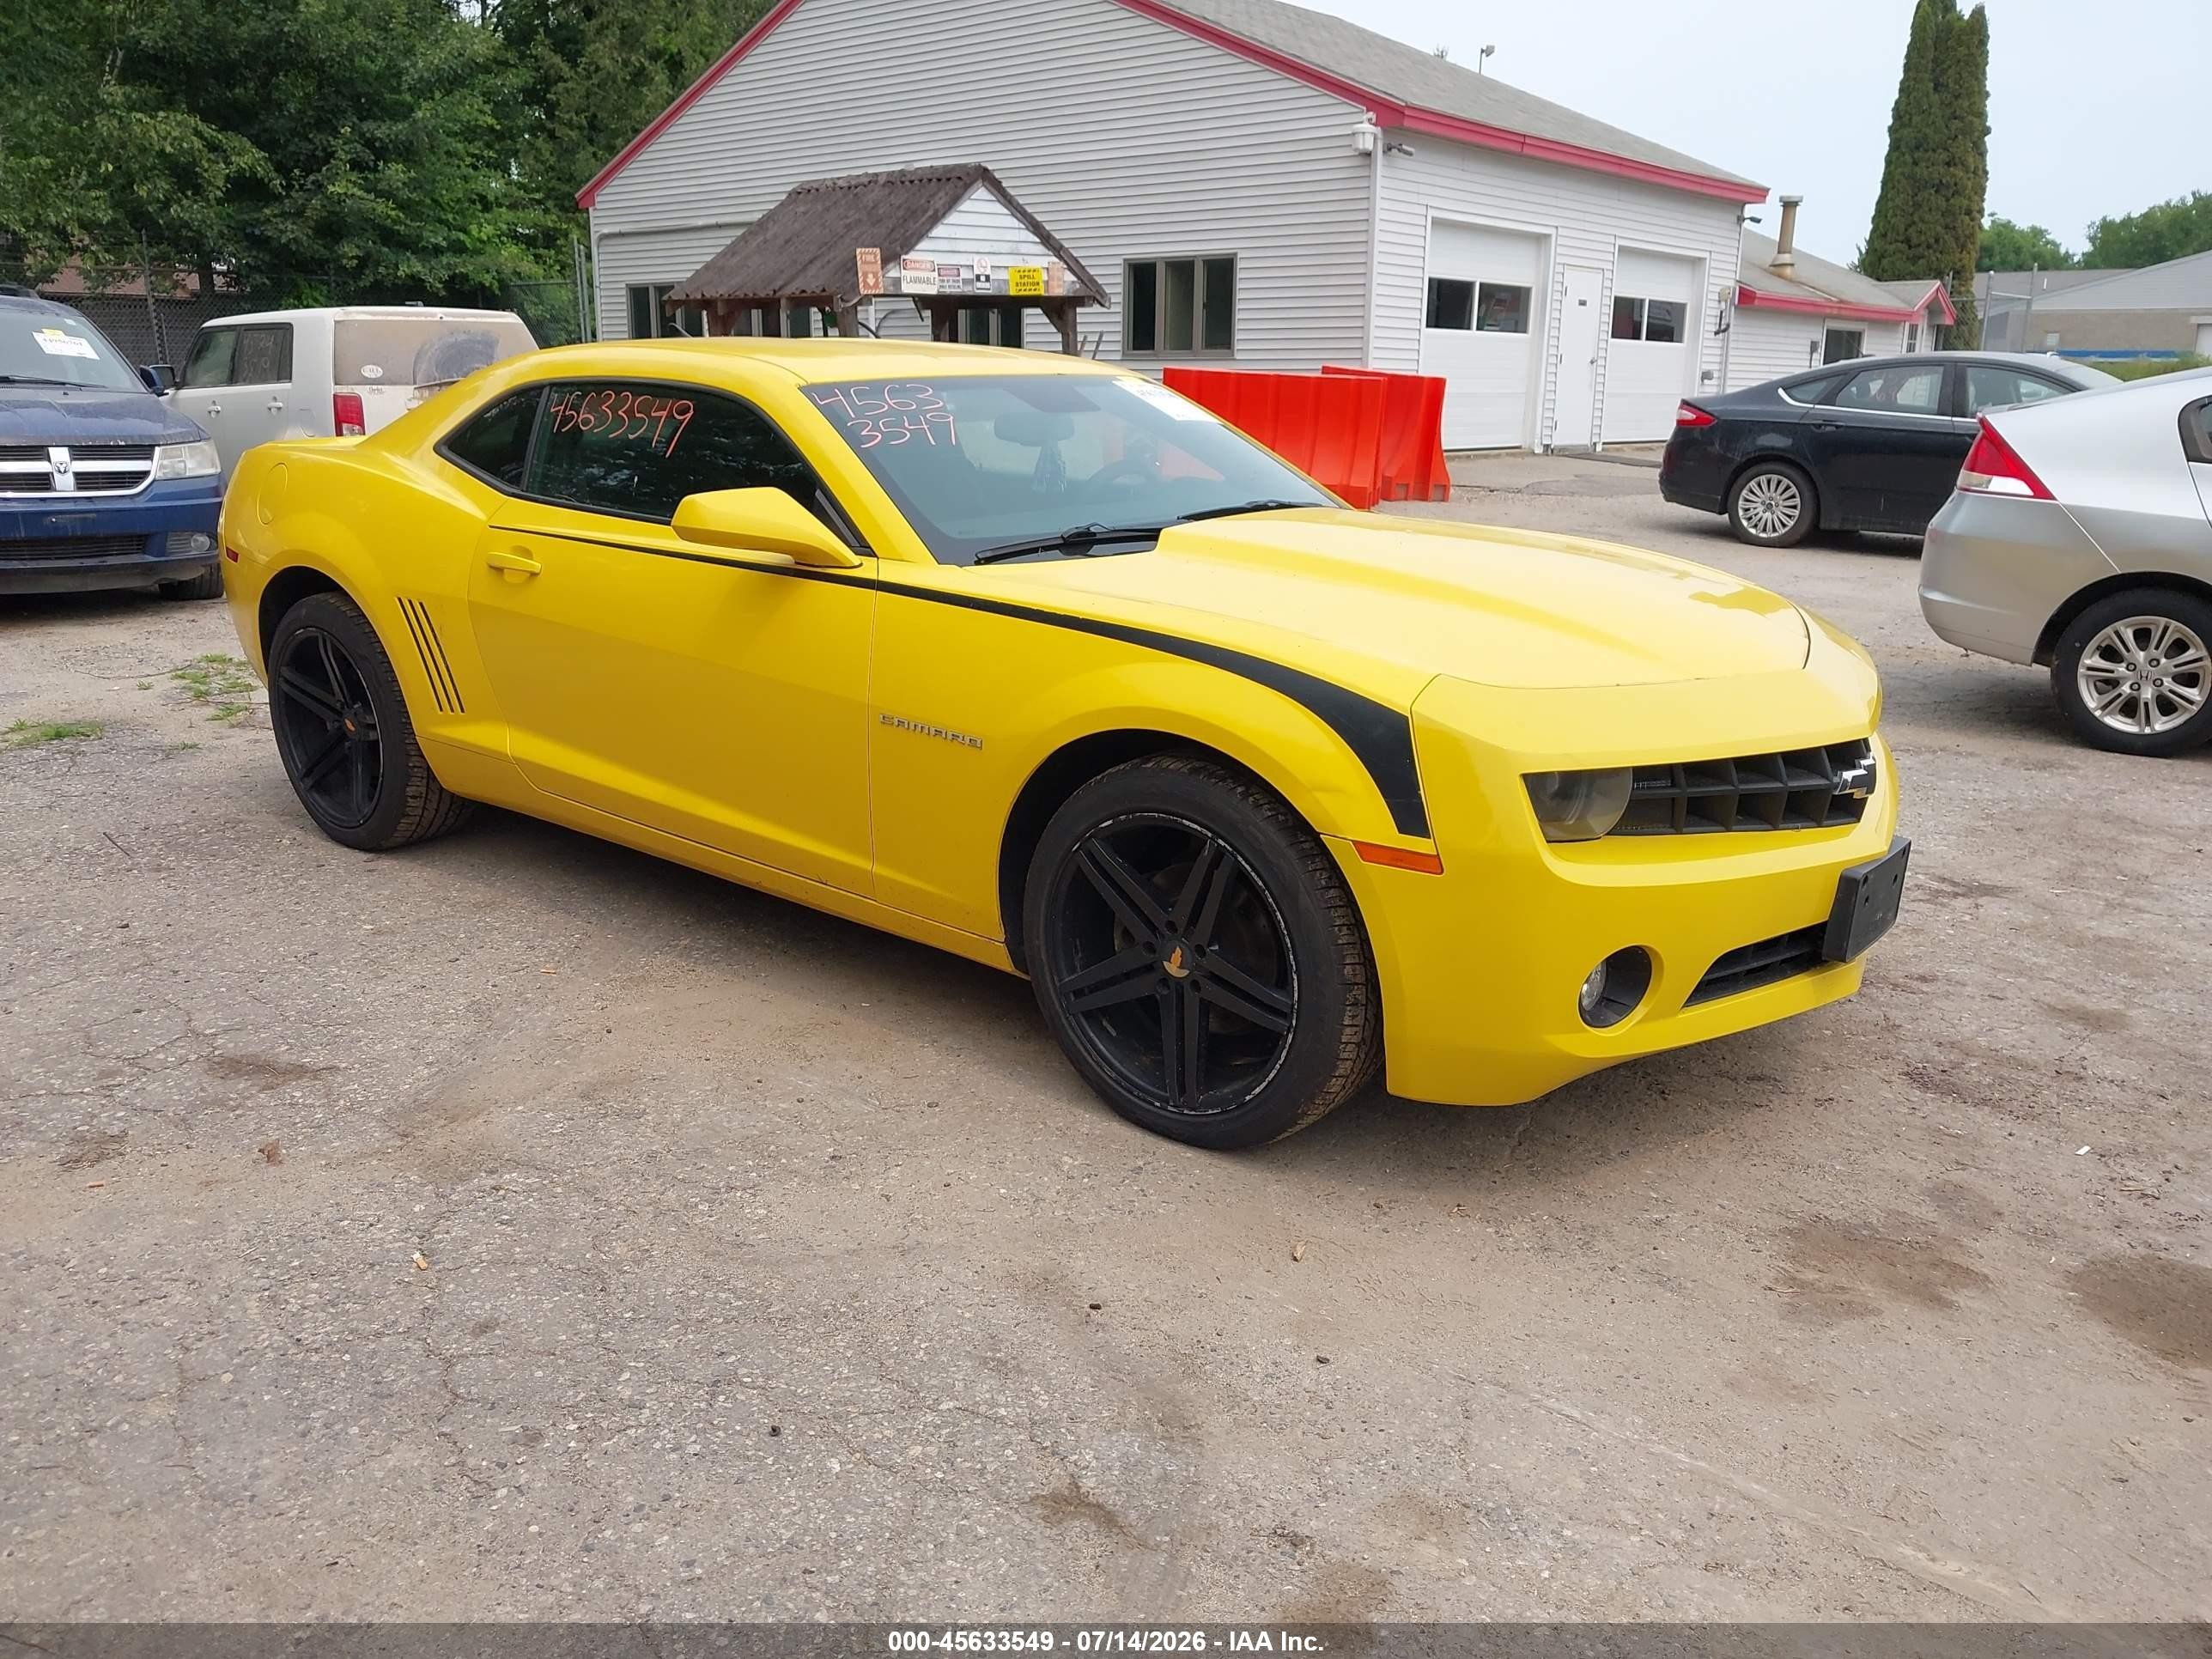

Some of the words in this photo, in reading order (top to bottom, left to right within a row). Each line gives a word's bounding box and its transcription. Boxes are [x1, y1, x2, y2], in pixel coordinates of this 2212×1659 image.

[902, 275, 937, 286] FLAMMABLE
[906, 259, 933, 270] DANGER
[811, 384, 944, 418] 4563
[550, 390, 694, 459] 45633549
[847, 412, 956, 448] 3549
[879, 713, 983, 750] CAMARO
